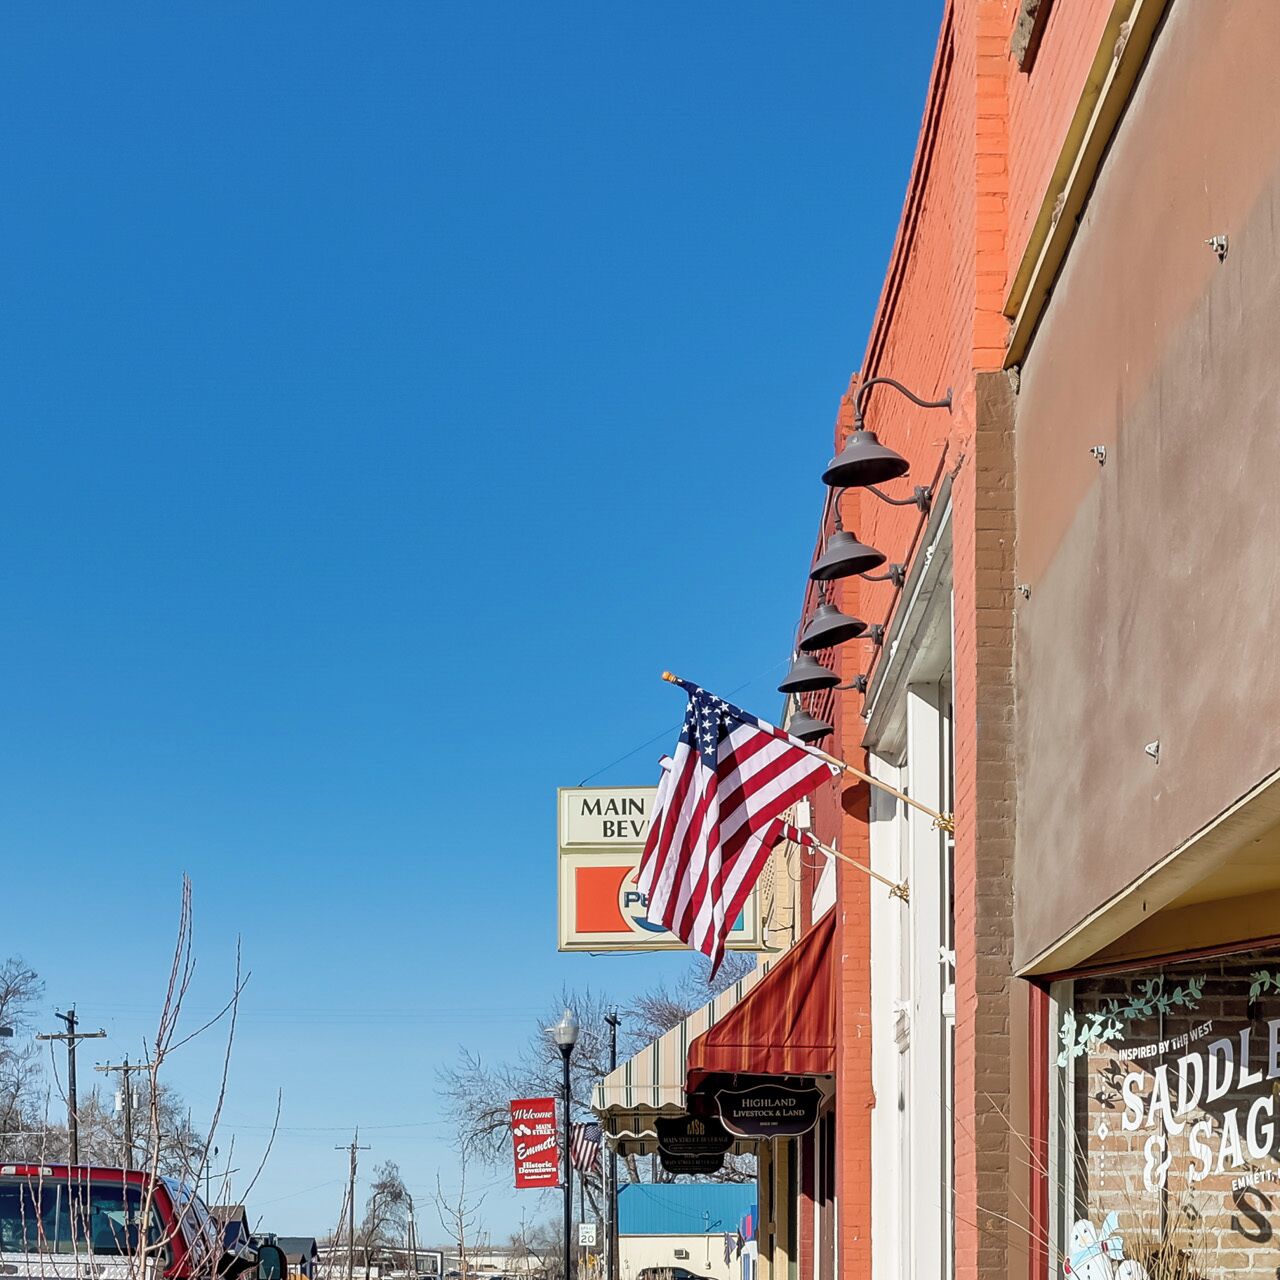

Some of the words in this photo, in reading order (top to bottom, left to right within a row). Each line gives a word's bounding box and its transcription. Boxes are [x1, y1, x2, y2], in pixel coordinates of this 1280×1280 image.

[580, 798, 645, 816] MAIN
[602, 820, 650, 838] BEV
[1118, 1043, 1158, 1062] INSPIRED
[1158, 1039, 1170, 1053] BY
[1171, 1034, 1188, 1050] THE
[1189, 1020, 1214, 1042] WEST
[741, 1098, 797, 1108] HIGHLAND
[513, 1108, 553, 1120] Welcome
[532, 1128, 556, 1136] STREET
[516, 1135, 557, 1160] Emmett
[522, 1161, 553, 1169] Historic
[1143, 1133, 1172, 1193] &
[581, 1234, 594, 1243] 20
